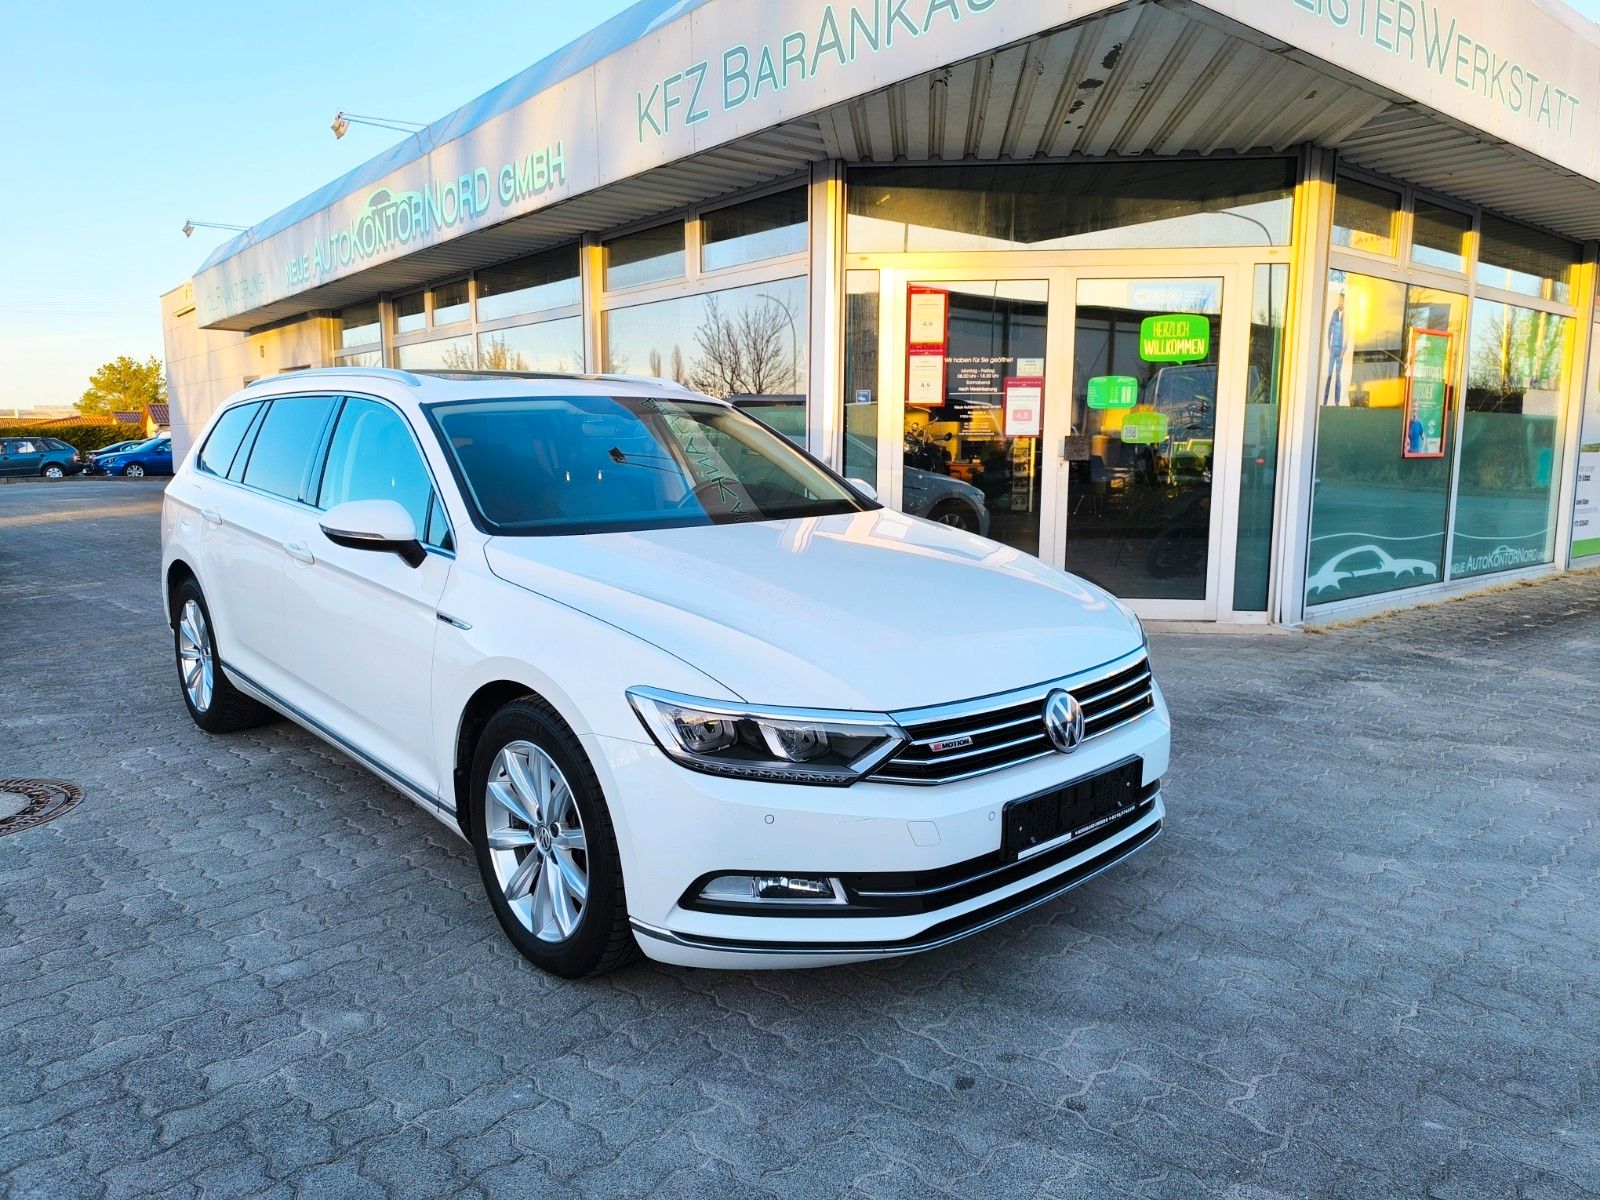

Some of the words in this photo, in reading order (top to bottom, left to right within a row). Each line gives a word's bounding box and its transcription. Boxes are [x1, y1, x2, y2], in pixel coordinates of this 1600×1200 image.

[637, 60, 710, 145] KFZ
[722, 0, 999, 112] BARANKA
[284, 254, 311, 285] NEUE
[1153, 320, 1190, 338] HERZLICH
[1143, 338, 1206, 356] WILLKOMMEN
